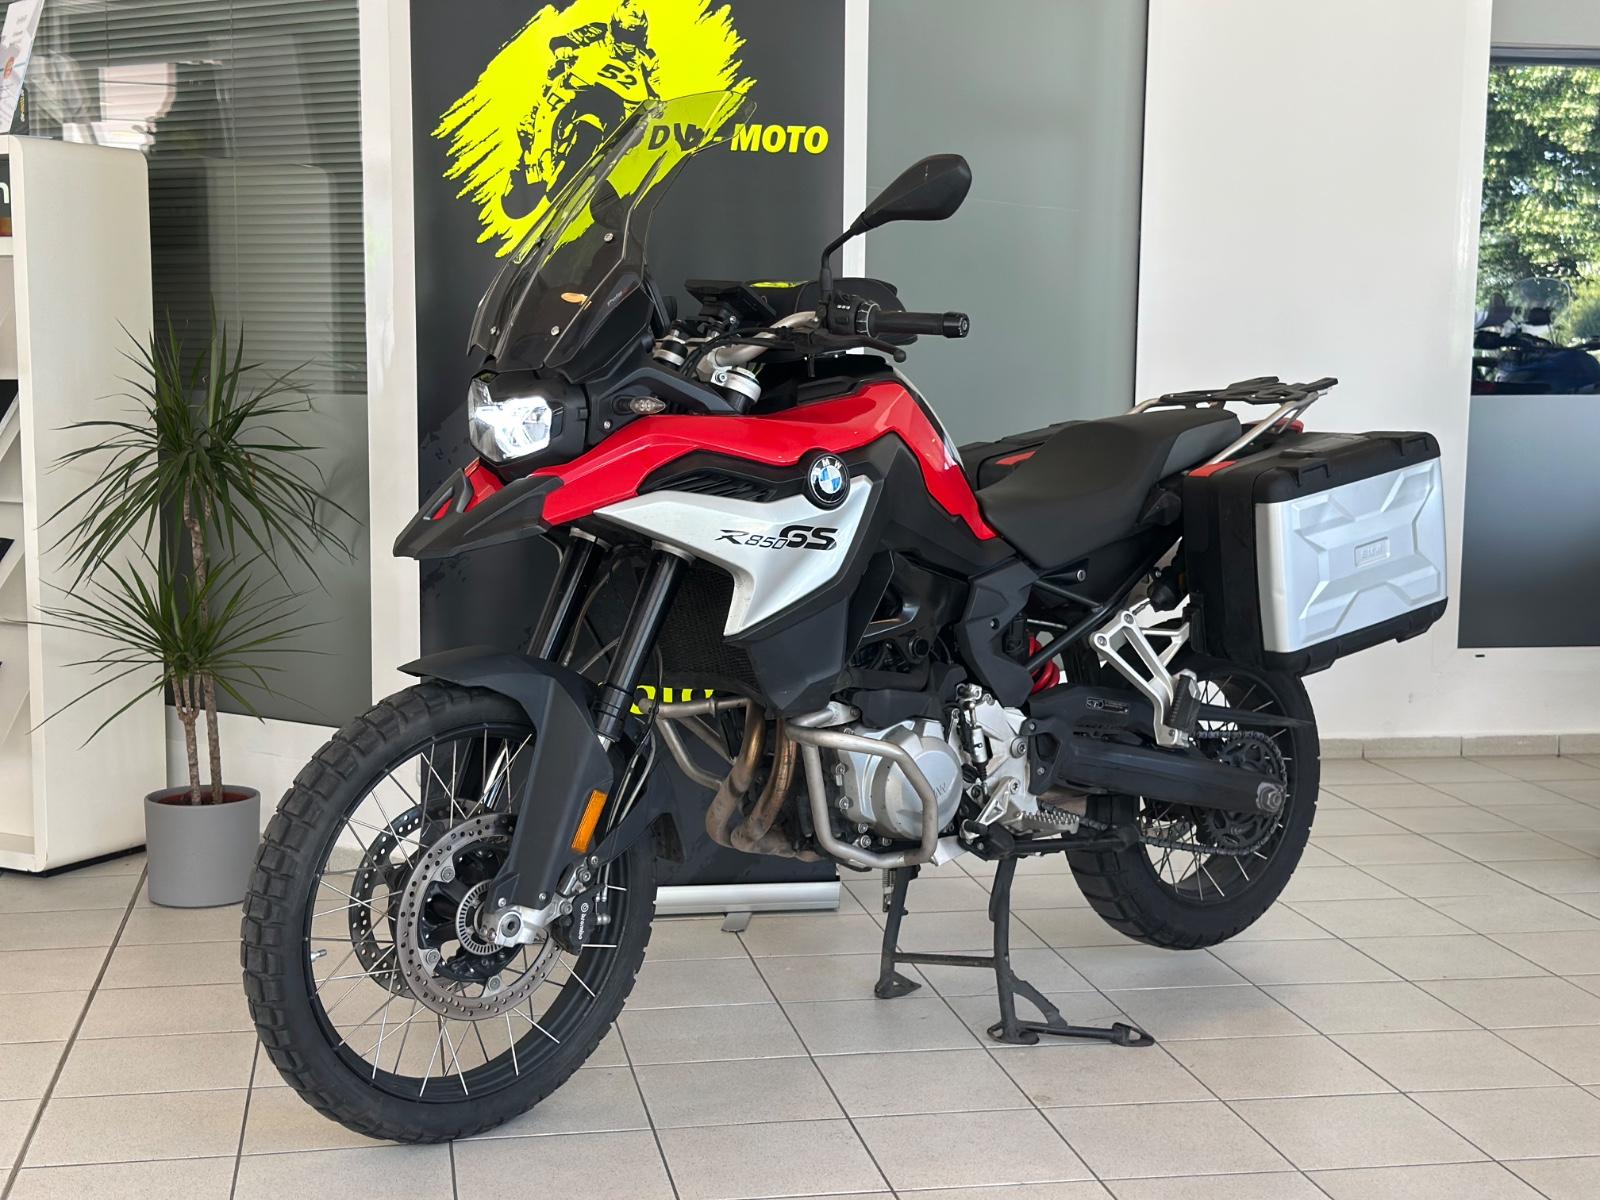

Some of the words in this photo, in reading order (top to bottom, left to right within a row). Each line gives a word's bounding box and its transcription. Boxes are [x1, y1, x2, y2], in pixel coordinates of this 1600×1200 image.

[597, 63, 637, 90] 52
[730, 123, 829, 154] MOTO
[578, 913, 587, 940] brembo
